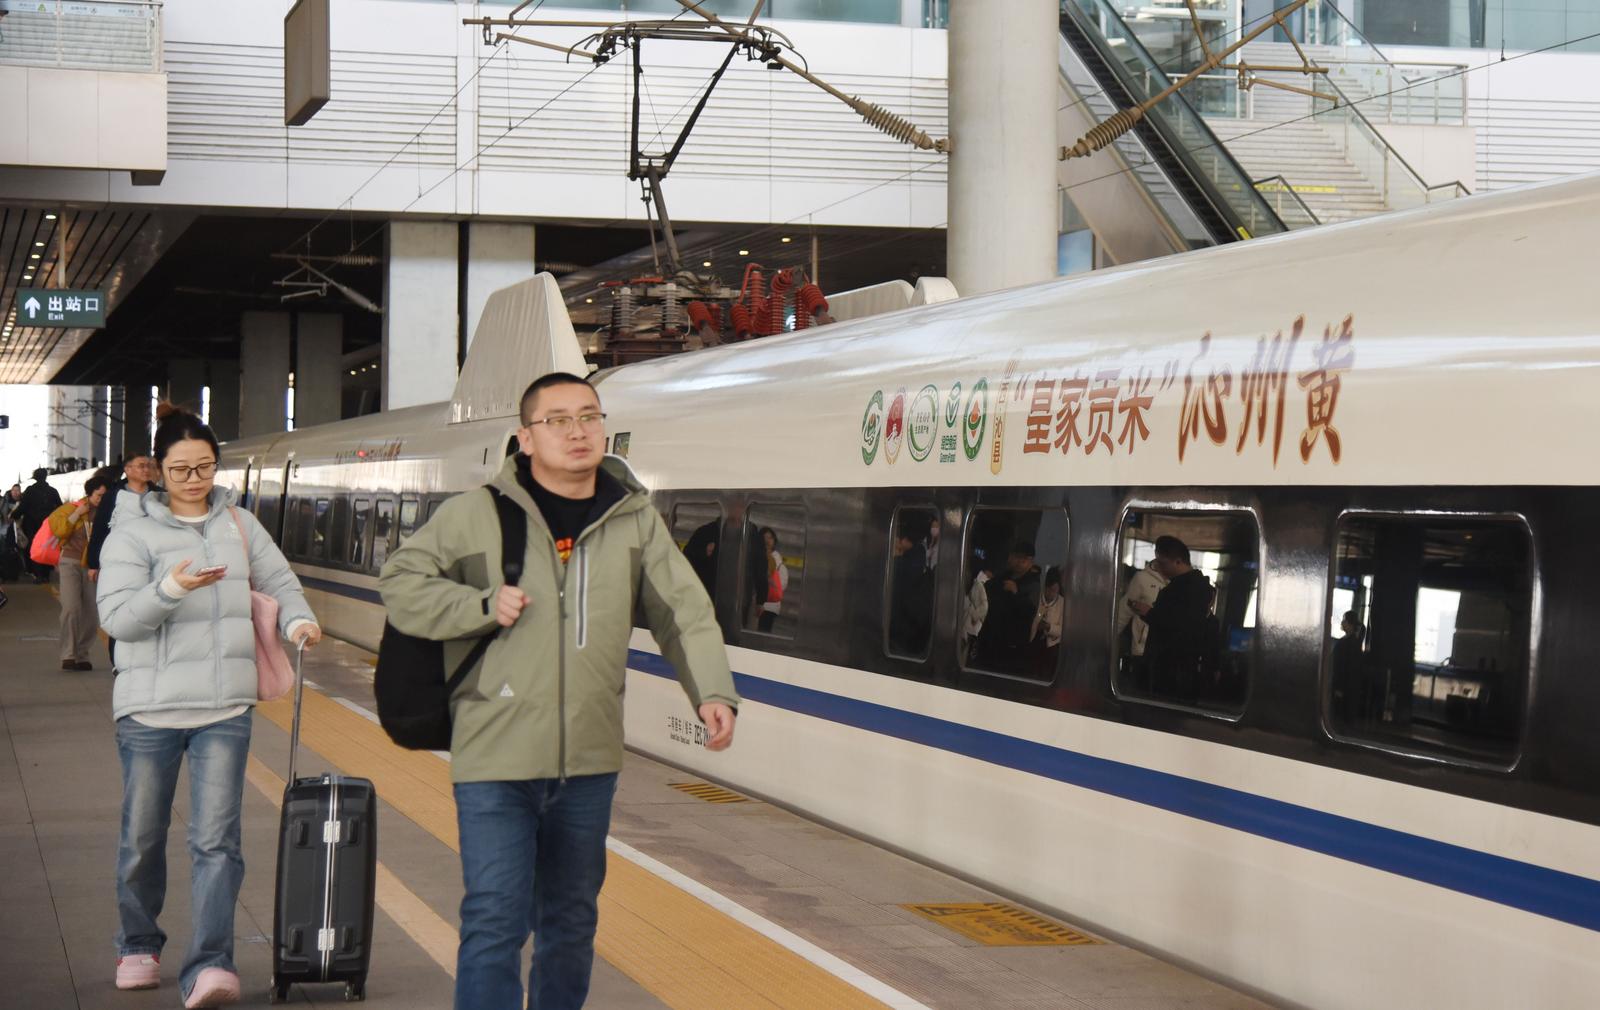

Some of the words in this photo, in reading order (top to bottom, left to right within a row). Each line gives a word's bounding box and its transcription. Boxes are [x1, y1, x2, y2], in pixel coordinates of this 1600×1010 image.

[48, 295, 99, 312] 出站口
[48, 312, 64, 321] Exit
